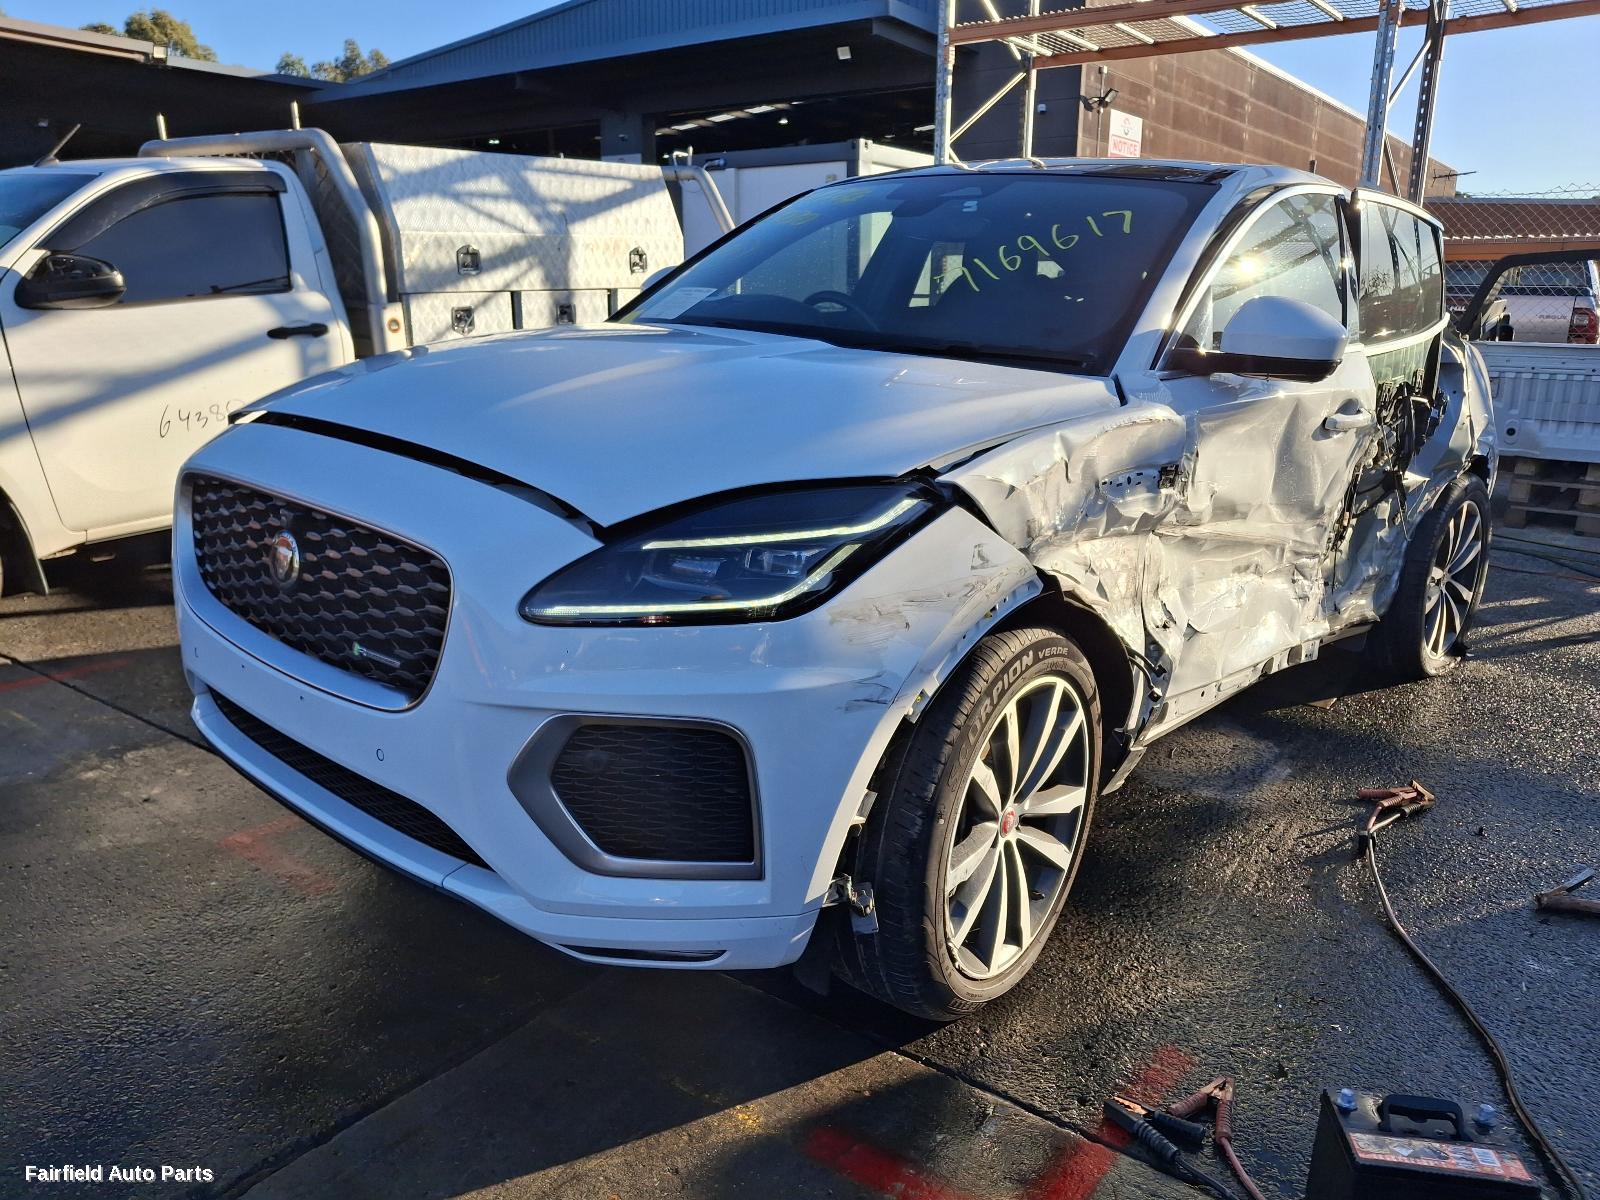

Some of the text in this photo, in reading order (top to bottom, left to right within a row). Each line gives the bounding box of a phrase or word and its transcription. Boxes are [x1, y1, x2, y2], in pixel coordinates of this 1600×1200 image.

[1112, 138, 1138, 157] NOTICE
[933, 210, 1132, 292] 7169617
[1038, 646, 1069, 659] VERDE
